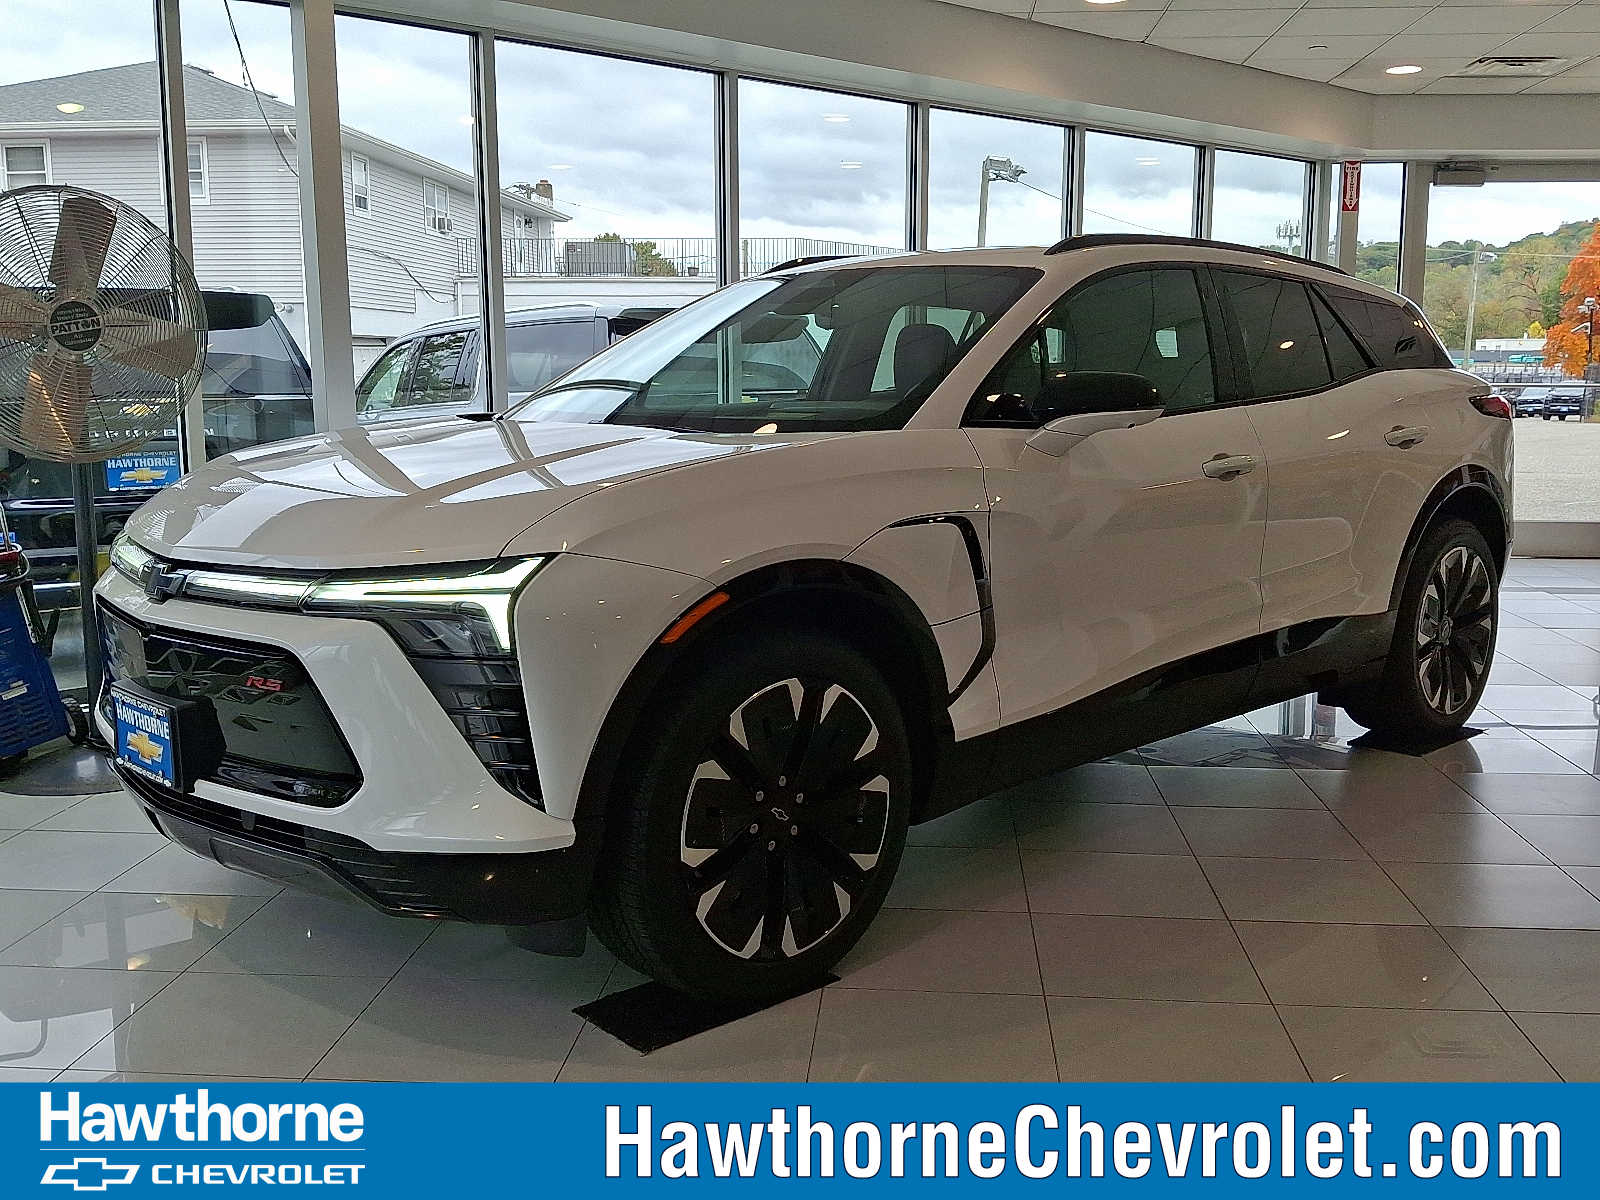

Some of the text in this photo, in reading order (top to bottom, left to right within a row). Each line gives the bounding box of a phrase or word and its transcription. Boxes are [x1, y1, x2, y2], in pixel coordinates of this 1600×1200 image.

[50, 316, 101, 335] PATTON
[107, 457, 177, 469] HAWTHORNE
[245, 676, 282, 691] RS
[116, 702, 170, 740] HAWTHORNE
